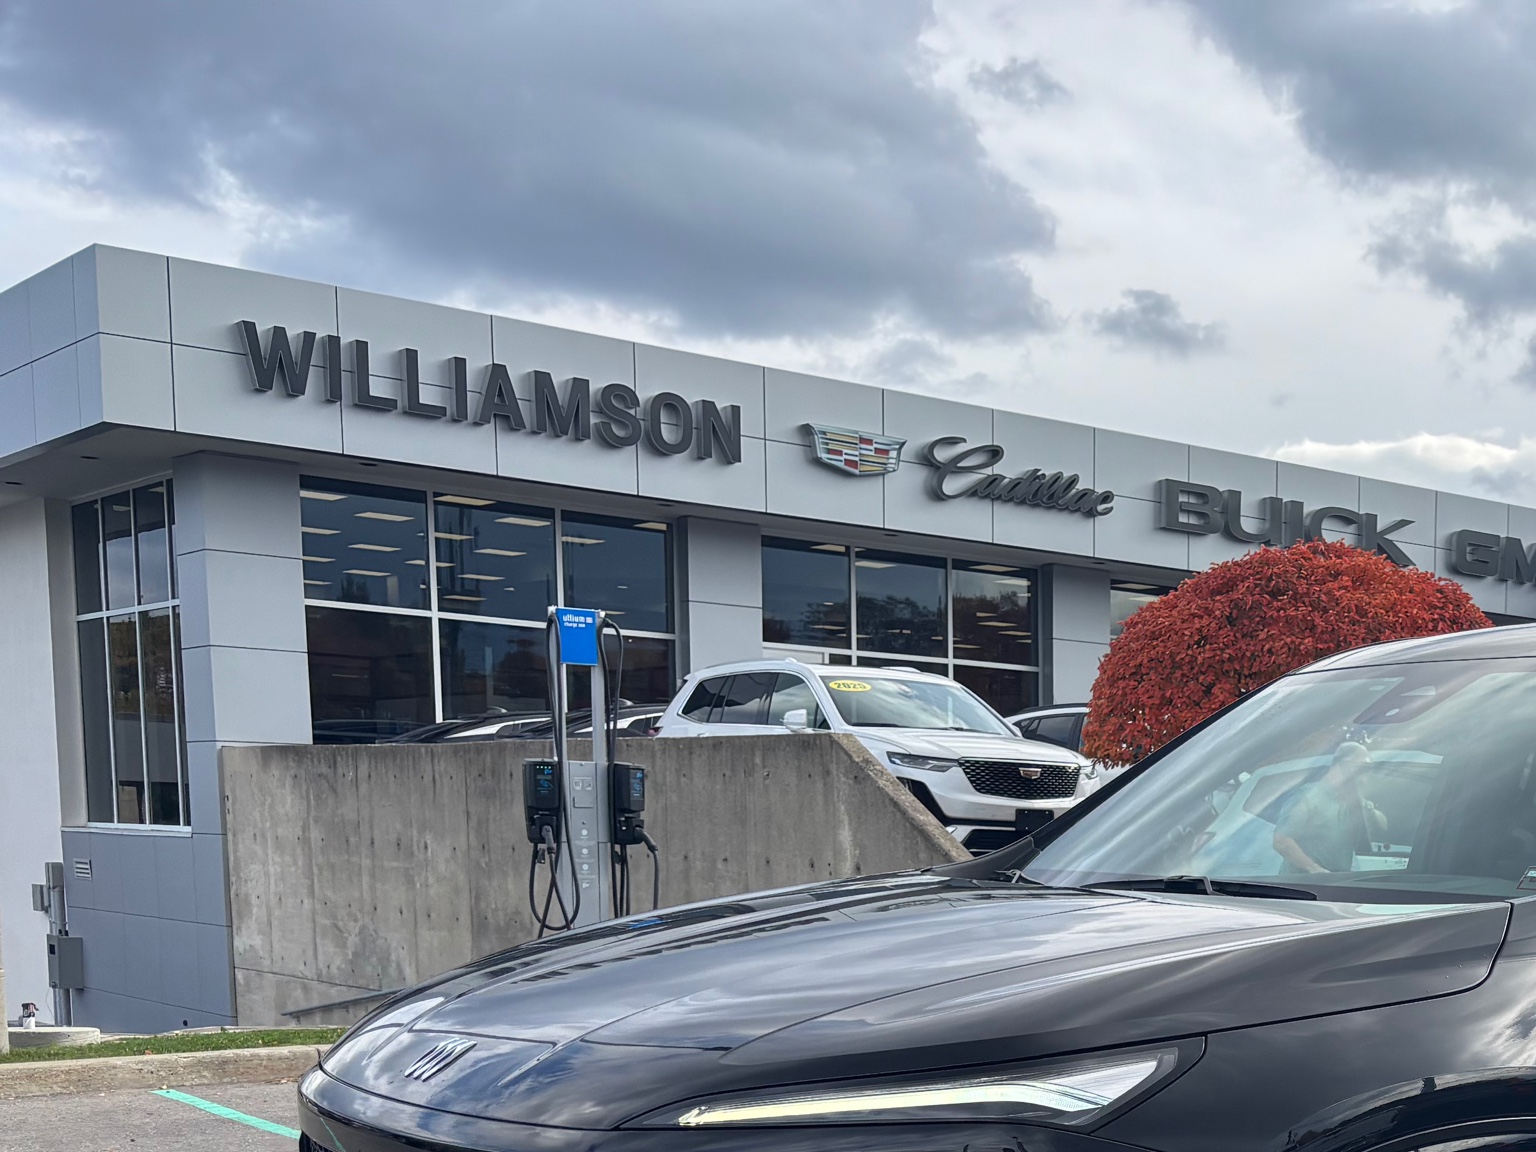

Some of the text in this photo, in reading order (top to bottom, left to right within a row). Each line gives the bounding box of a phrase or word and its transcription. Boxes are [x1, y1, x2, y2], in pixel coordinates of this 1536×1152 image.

[235, 319, 742, 464] WILLIAMSON
[924, 436, 1115, 517] Cadillac
[1156, 478, 1417, 567] BUICK
[834, 682, 867, 690] 2025
